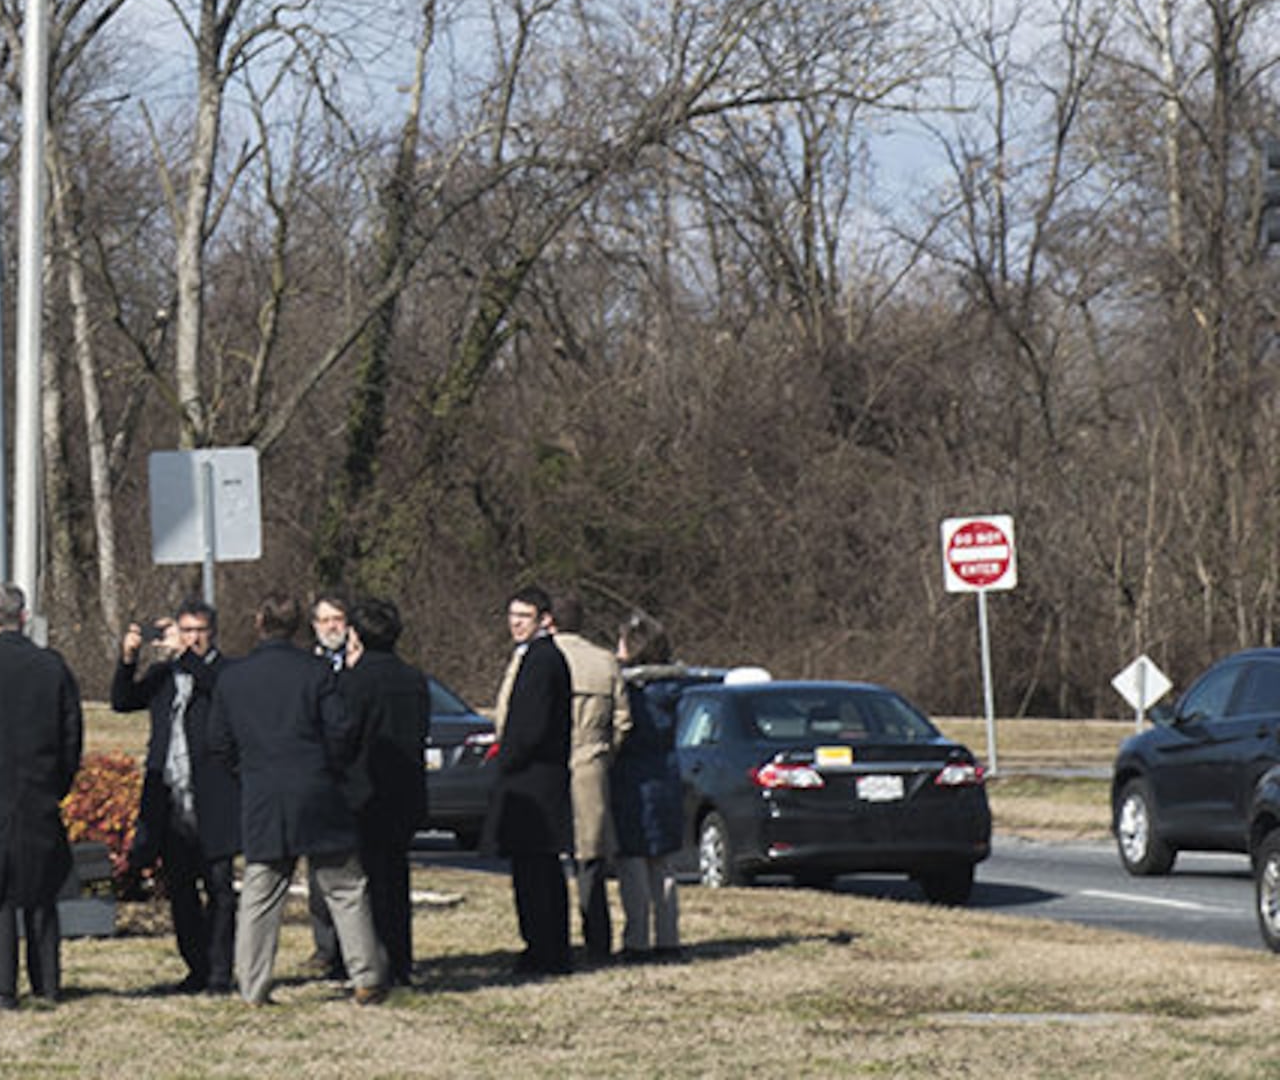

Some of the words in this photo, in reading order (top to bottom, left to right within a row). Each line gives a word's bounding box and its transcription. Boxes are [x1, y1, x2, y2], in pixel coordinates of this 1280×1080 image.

[953, 533, 973, 546] DO
[976, 531, 1002, 545] NOT
[961, 562, 1000, 576] ENTER
